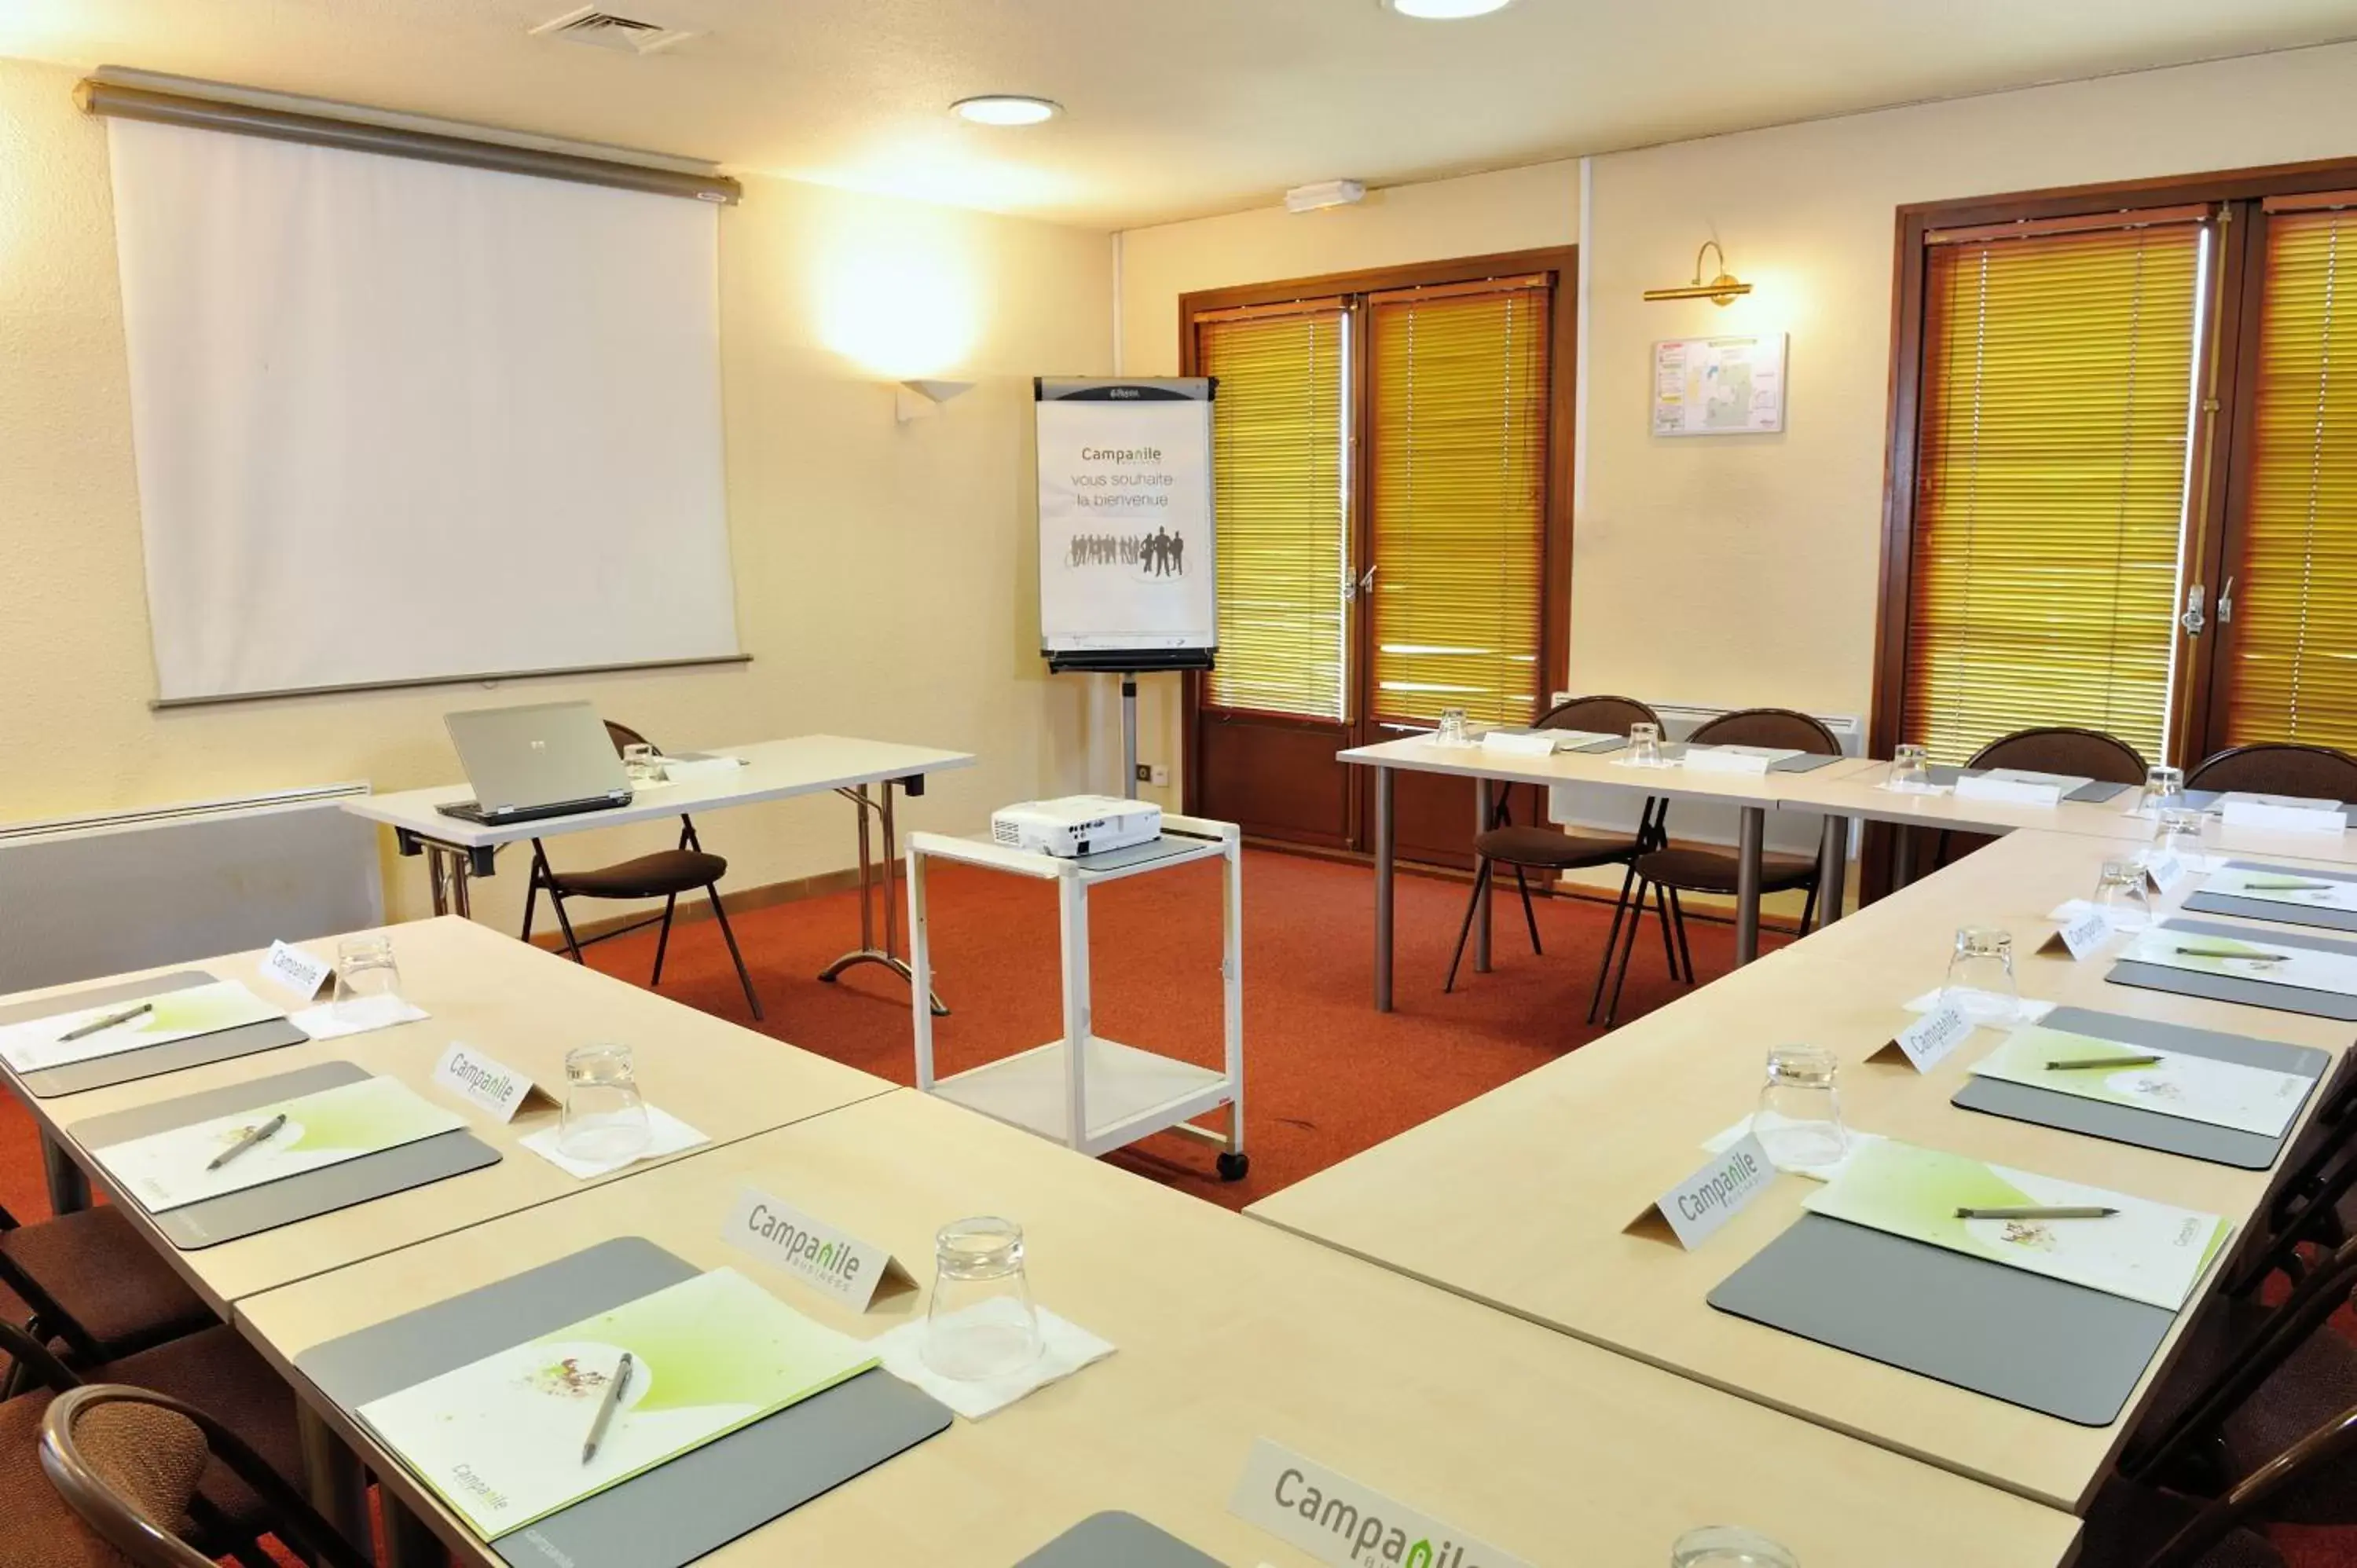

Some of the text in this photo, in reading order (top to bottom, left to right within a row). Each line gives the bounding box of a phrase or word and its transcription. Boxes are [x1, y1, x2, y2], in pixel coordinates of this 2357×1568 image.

[1071, 473, 1173, 486] vous souhaite
[1082, 447, 1162, 464] Campanile
[1076, 493, 1168, 507] la bienvenue
[450, 1053, 514, 1102] Campanile
[1677, 1151, 1758, 1222] Campanile
[748, 1203, 860, 1280] Campanile
[1274, 1468, 1482, 1568] Campanil
